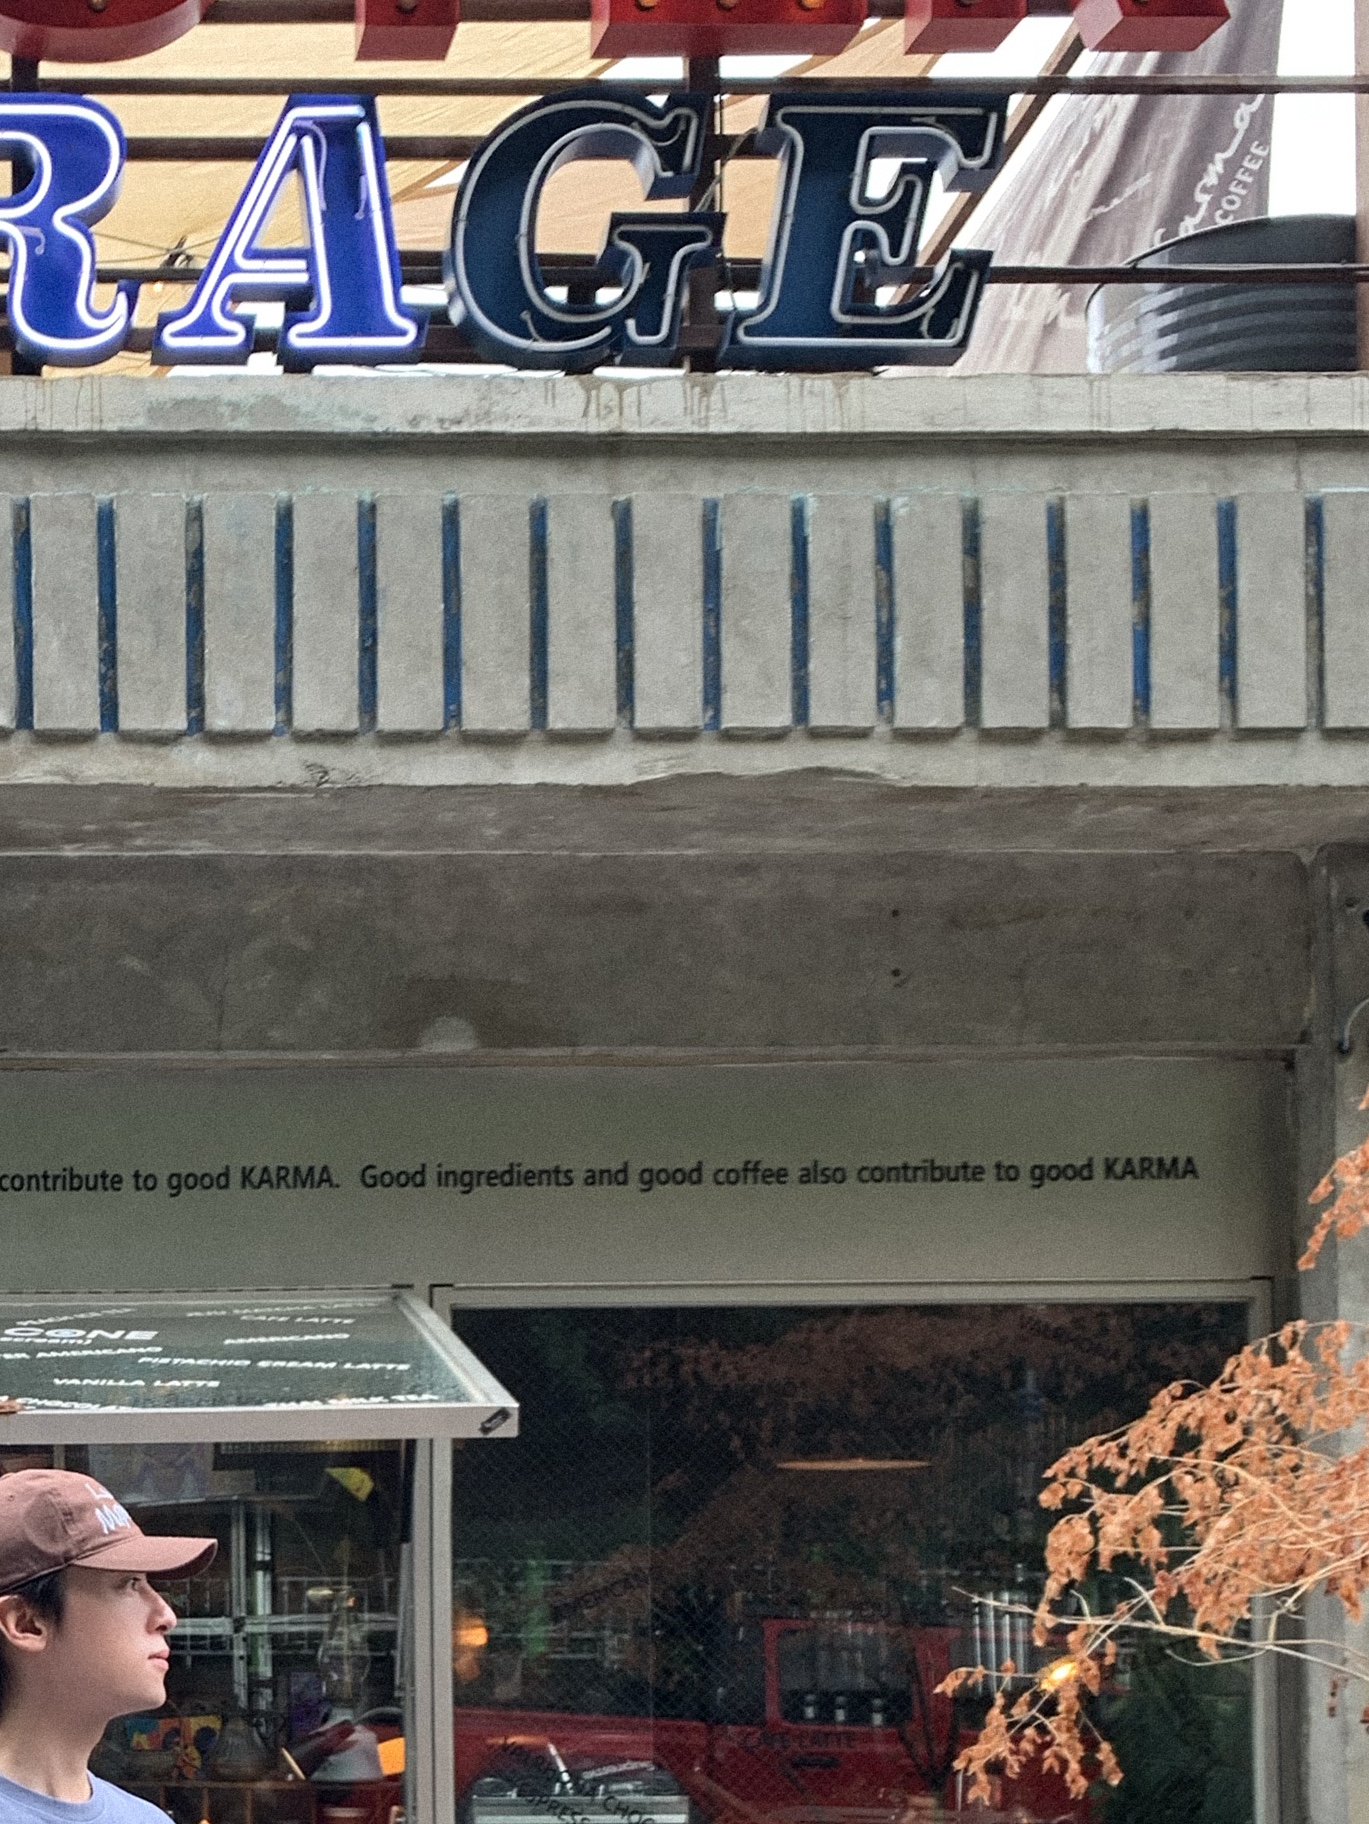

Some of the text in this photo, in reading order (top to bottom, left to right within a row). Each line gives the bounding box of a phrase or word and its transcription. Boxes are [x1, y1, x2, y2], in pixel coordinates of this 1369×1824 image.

[1214, 141, 1270, 226] COFFEE
[132, 1169, 158, 1192] to
[167, 1165, 230, 1198] good
[240, 1164, 340, 1190] KARMA.
[360, 1163, 427, 1189] Good
[437, 1162, 574, 1195] ingredients
[583, 1161, 629, 1187] and
[639, 1160, 703, 1193] good
[713, 1159, 789, 1186] coffee
[798, 1159, 847, 1185] also
[856, 1158, 986, 1184] contribute
[994, 1161, 1020, 1182] to
[1029, 1157, 1094, 1189] good
[1104, 1156, 1199, 1181] KARMA
[3, 1326, 160, 1341] CONE
[137, 1356, 411, 1371] PISTACHIO CREAM LATTE
[53, 1377, 221, 1388] VANILLA LATTE
